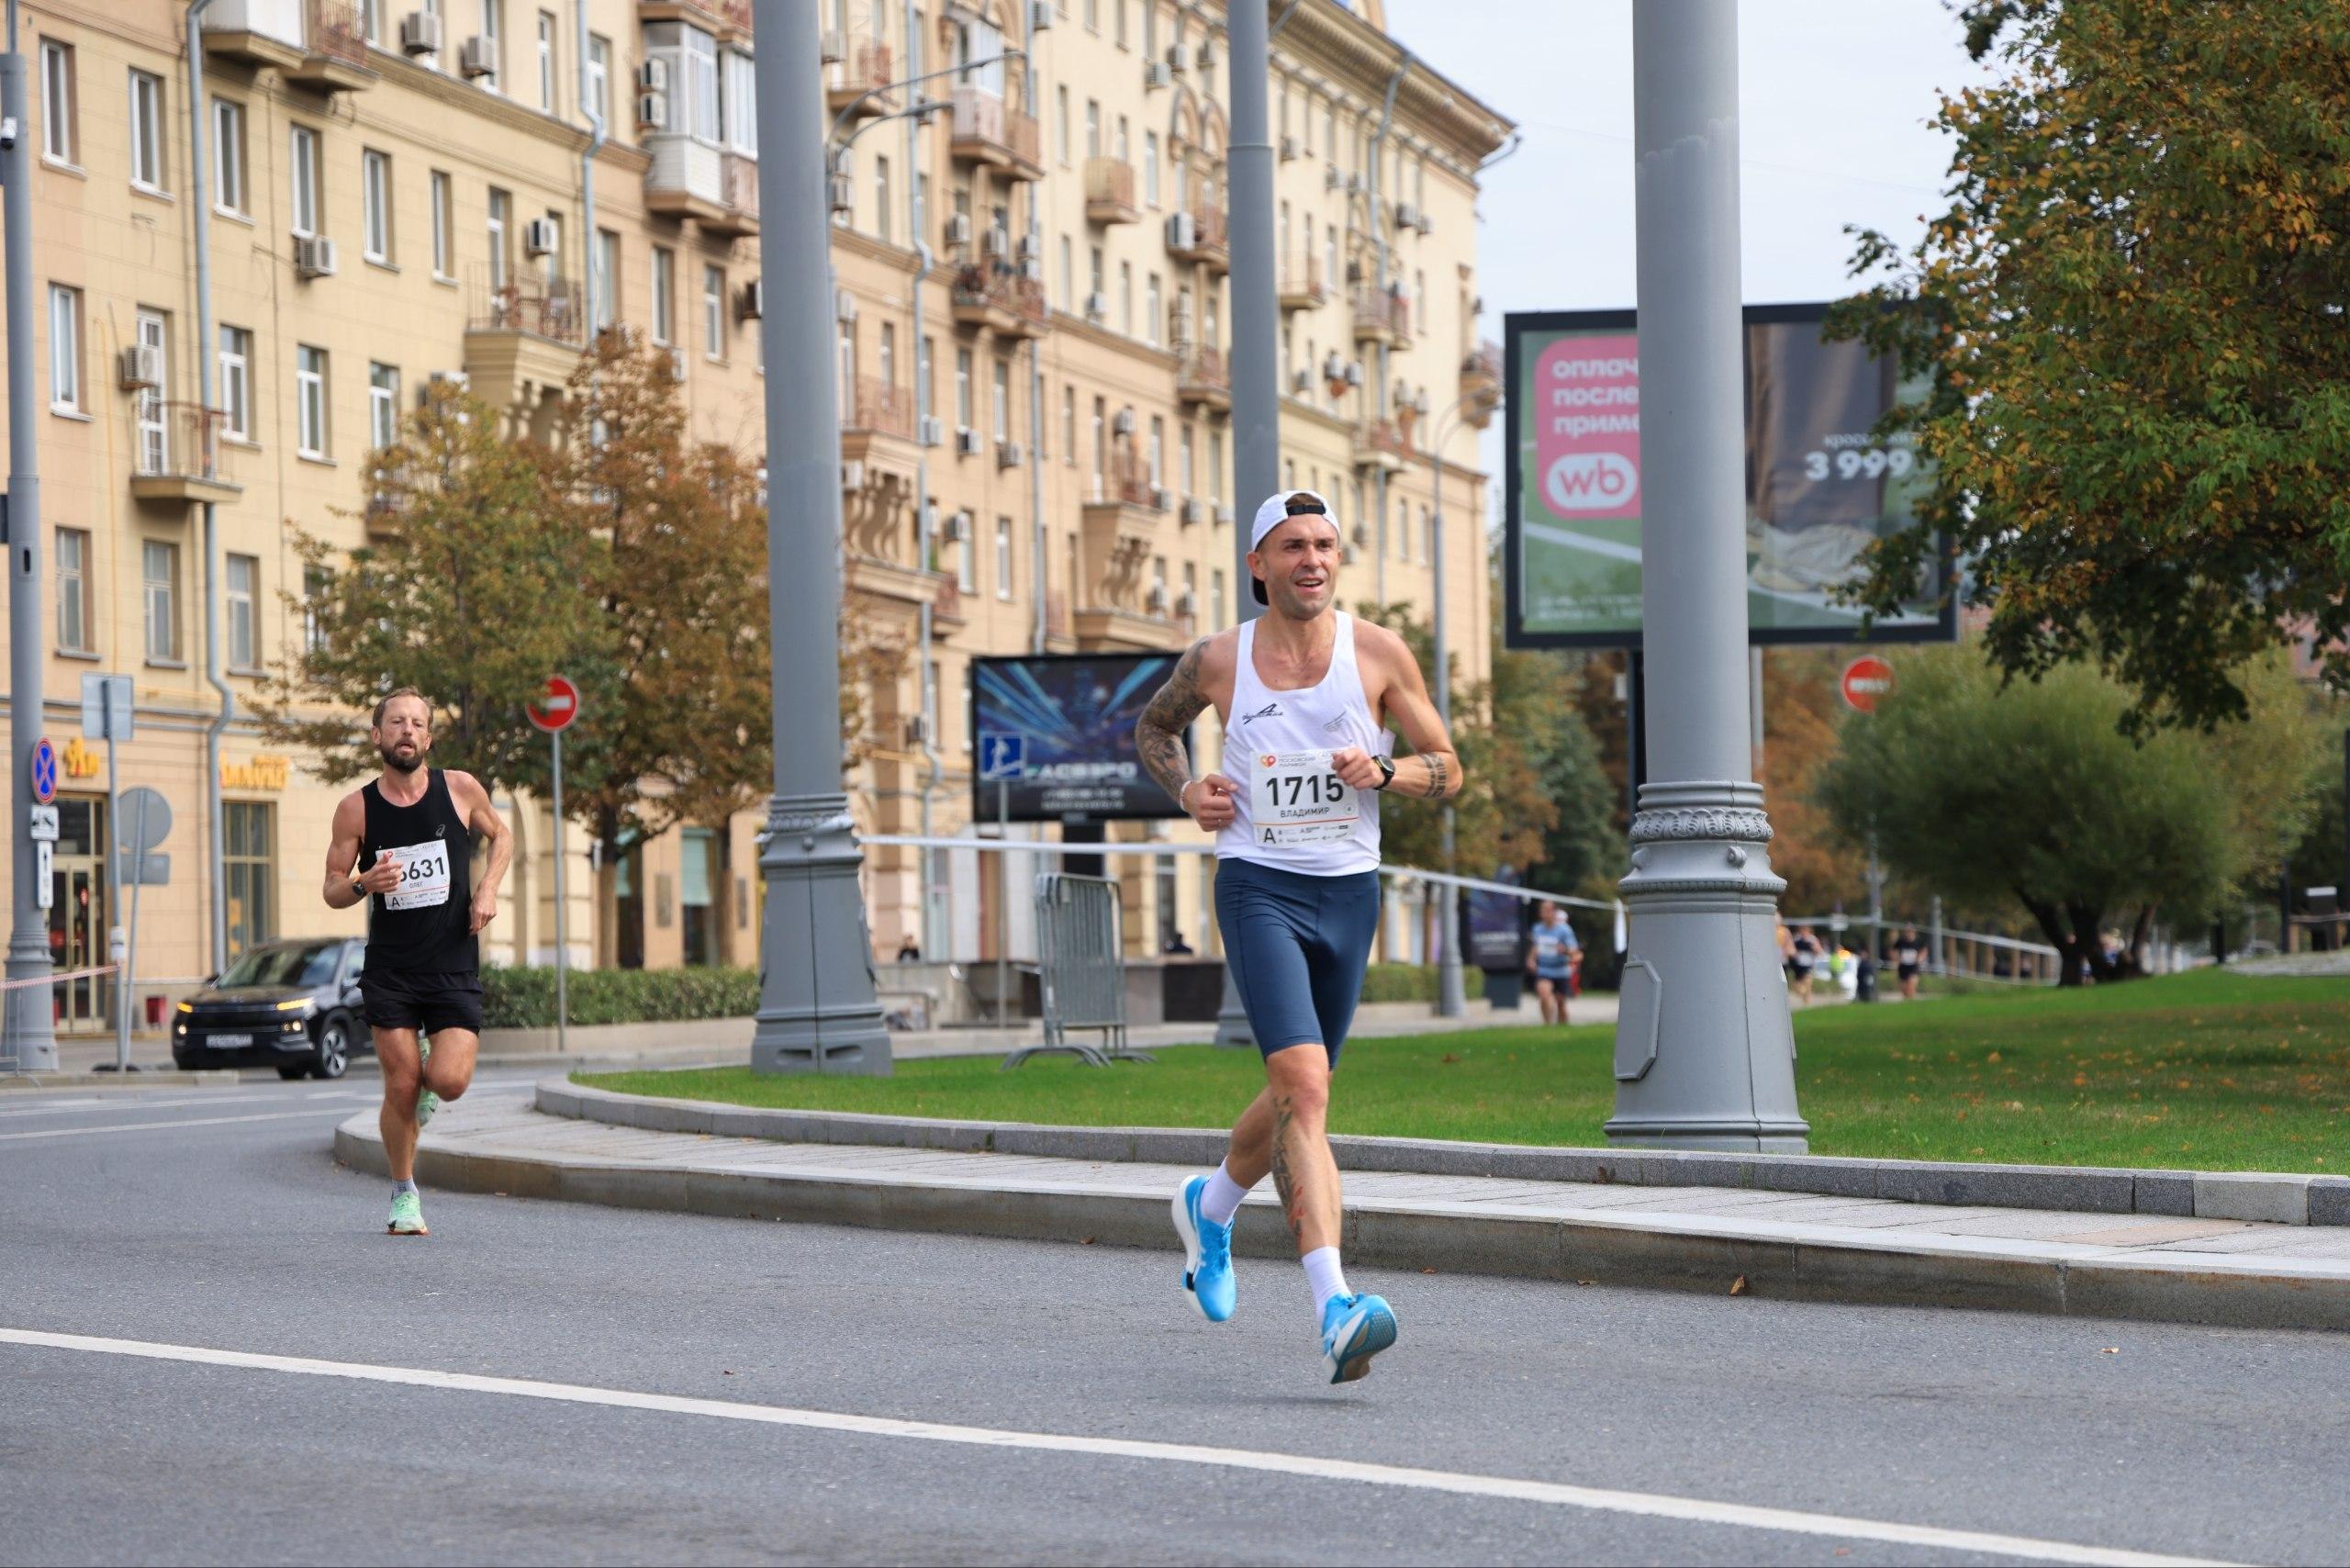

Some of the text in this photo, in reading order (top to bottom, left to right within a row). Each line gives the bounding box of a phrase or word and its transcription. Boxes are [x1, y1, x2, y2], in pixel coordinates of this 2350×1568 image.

[1553, 386, 1639, 407] после
[1805, 448, 1913, 481] 3 999
[1559, 458, 1626, 498] wb
[1266, 774, 1344, 806] 1715
[1280, 807, 1330, 818] ВЛАДИМИР
[1263, 828, 1276, 844] A
[391, 897, 400, 907] A
